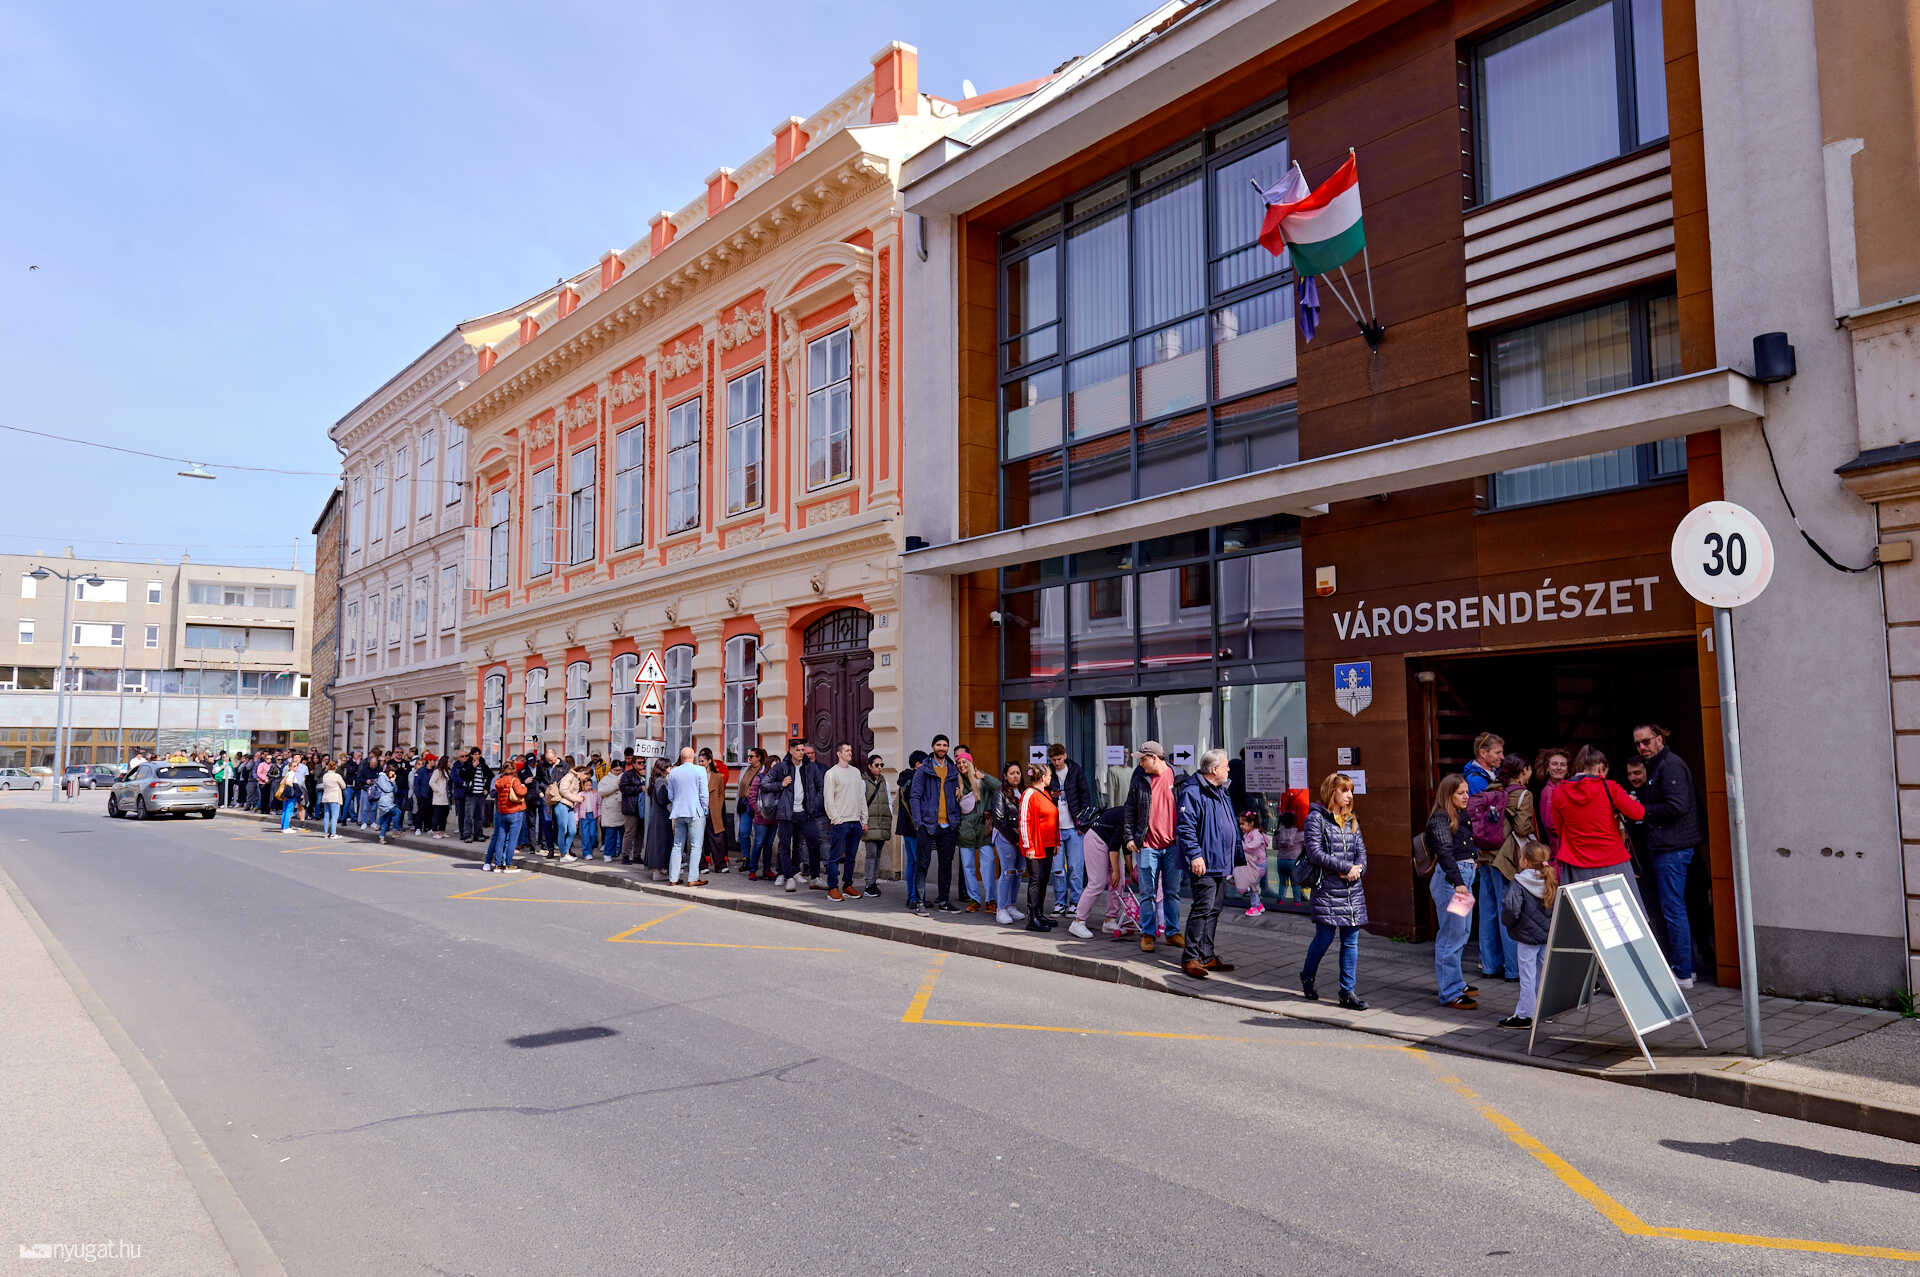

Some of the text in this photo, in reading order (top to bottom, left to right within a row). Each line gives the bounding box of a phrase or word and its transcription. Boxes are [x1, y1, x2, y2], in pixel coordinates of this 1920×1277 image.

[1703, 532, 1747, 576] 30
[1333, 576, 1660, 641] VÁROSRENDÉSZET
[1701, 627, 1714, 652] 1
